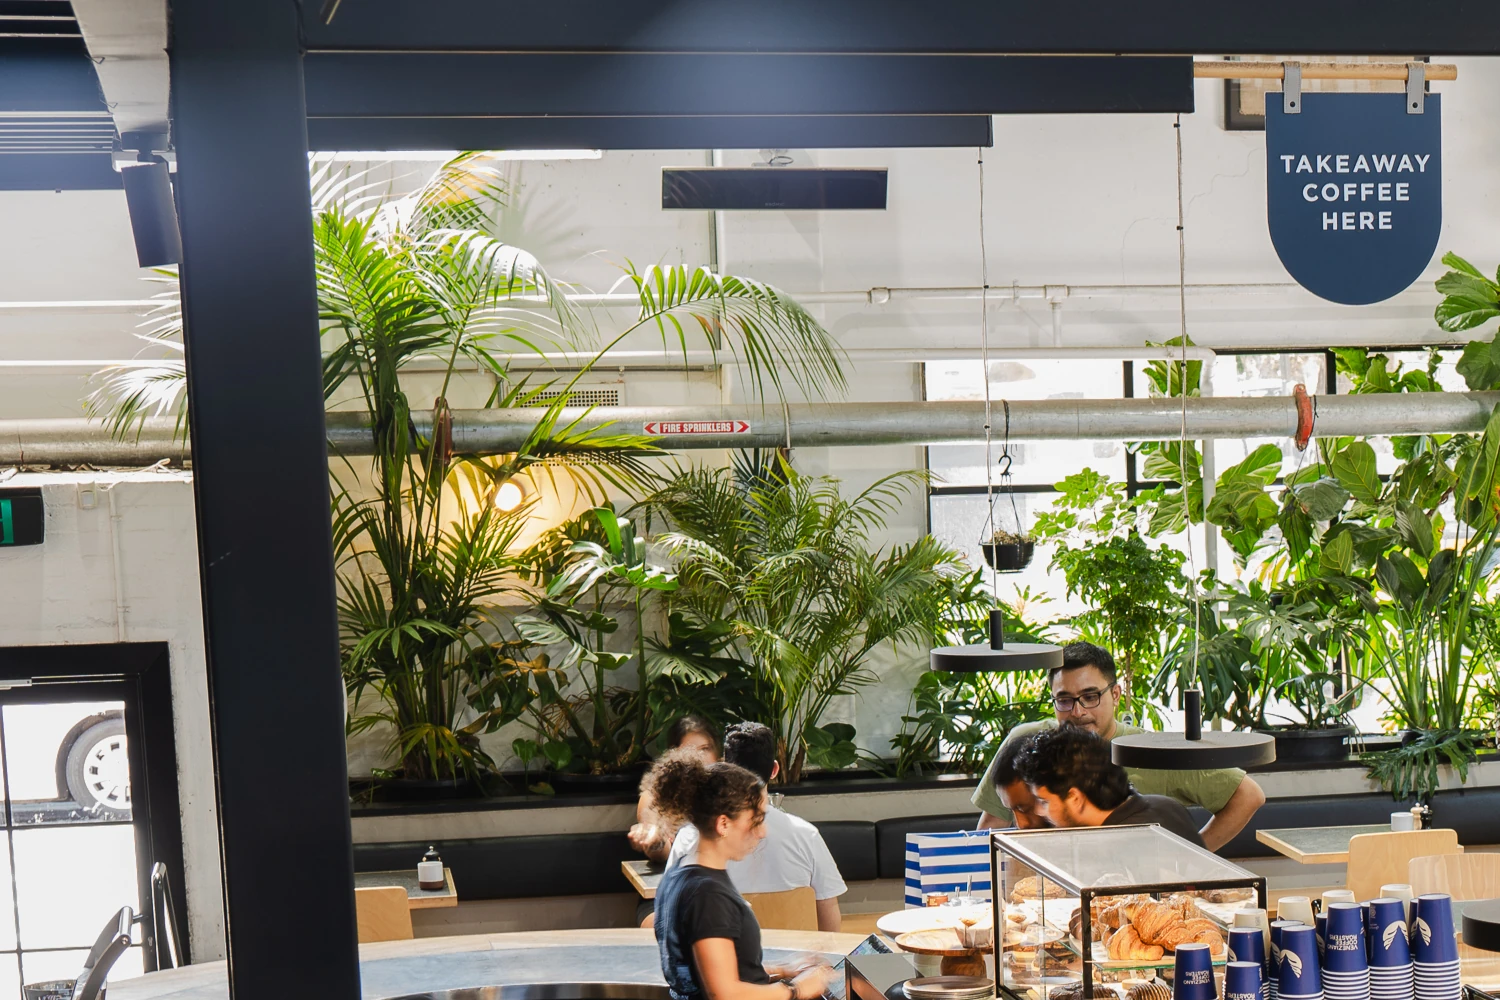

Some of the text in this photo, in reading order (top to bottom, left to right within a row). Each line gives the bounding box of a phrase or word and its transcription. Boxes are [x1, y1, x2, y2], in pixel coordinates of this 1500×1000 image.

[1280, 154, 1430, 173] TAKEAWAY
[1302, 182, 1410, 202] COFFEE
[1322, 211, 1393, 231] HERE
[663, 422, 732, 433] FIRE SPRINKLERS
